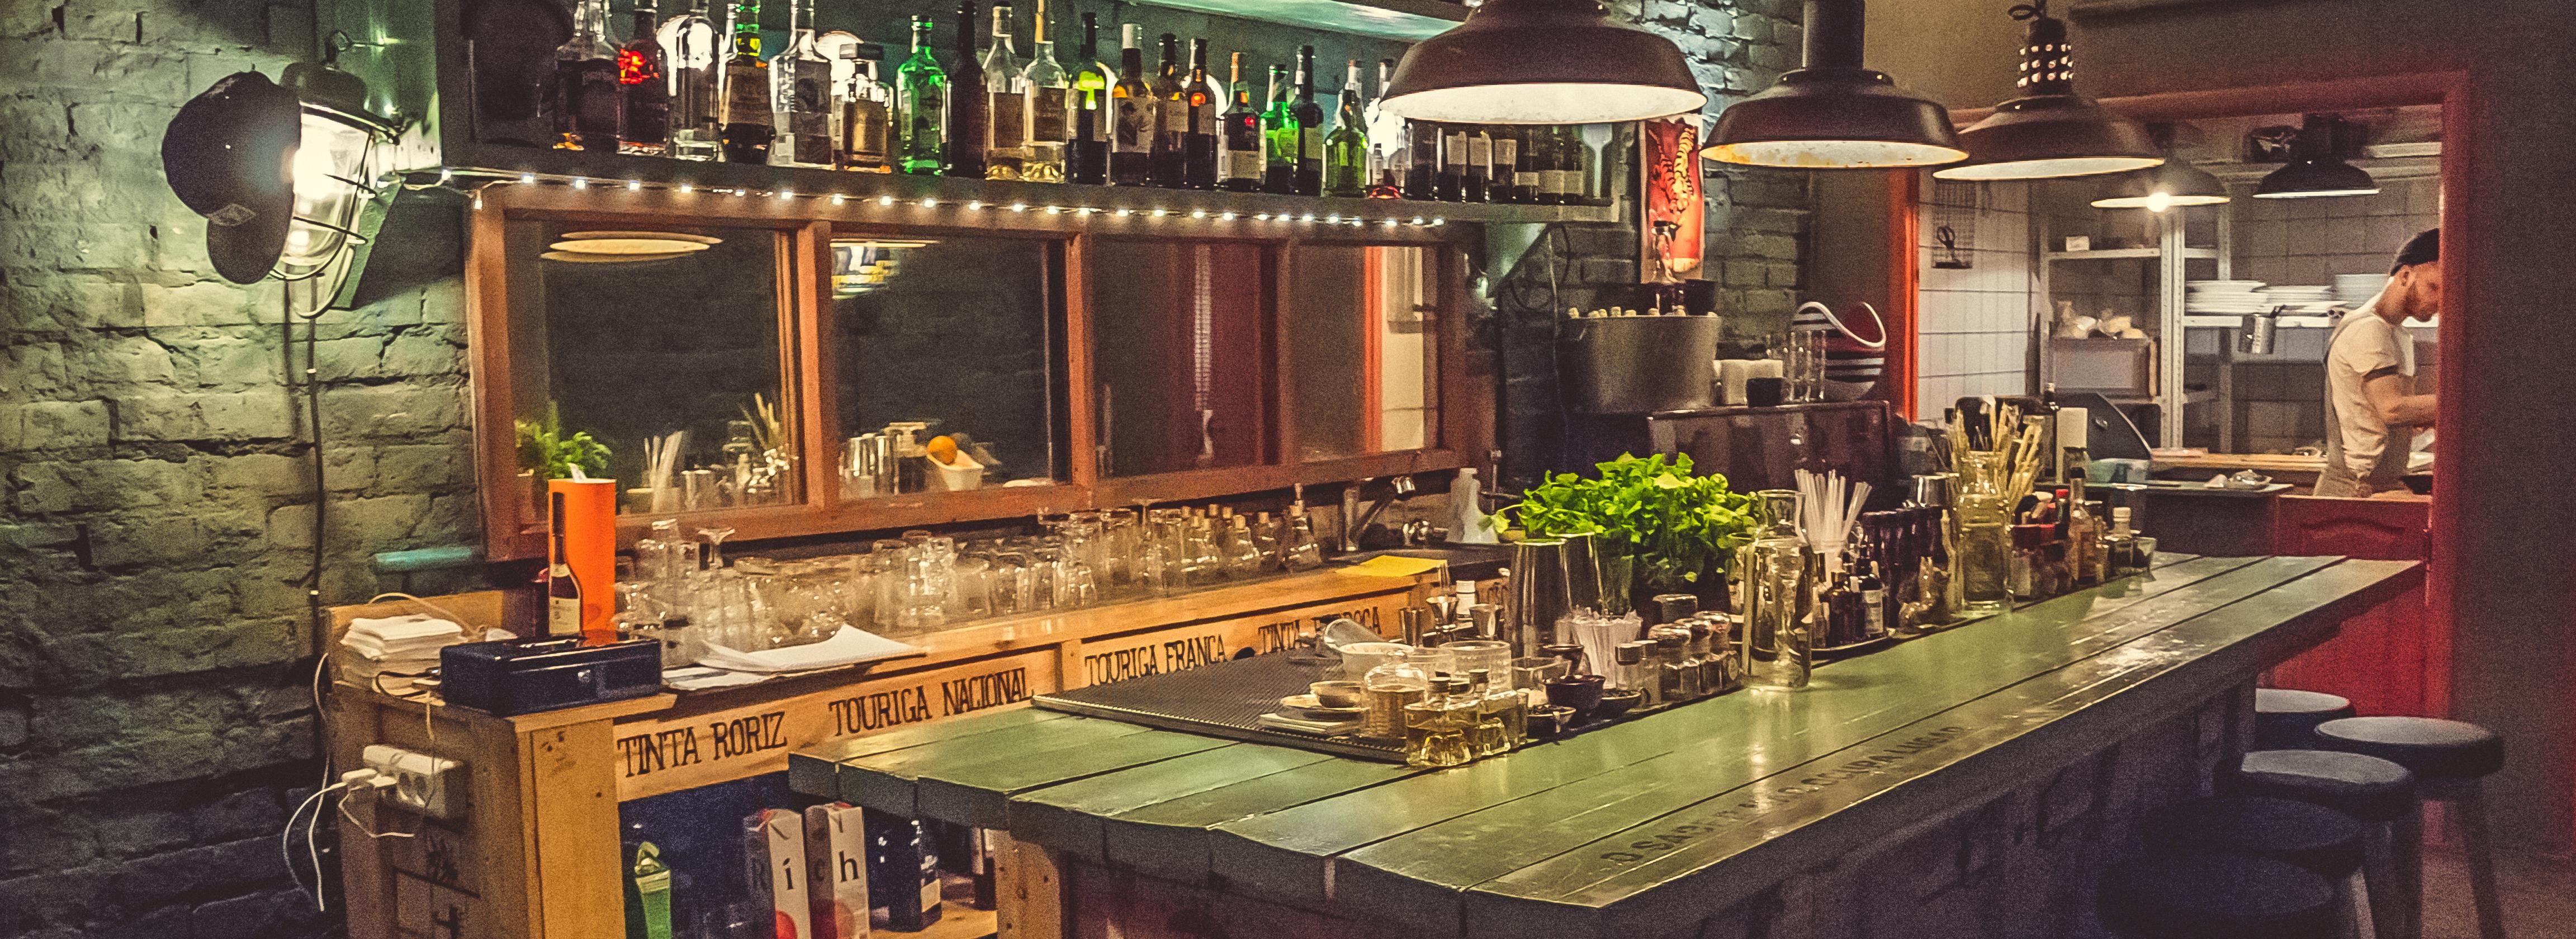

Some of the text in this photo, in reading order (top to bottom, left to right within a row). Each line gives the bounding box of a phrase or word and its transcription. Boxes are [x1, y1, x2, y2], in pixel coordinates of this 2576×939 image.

[1085, 633, 1228, 686] TOURIGA FRANCA
[1258, 619, 1301, 656] TINTA
[828, 667, 1033, 737] TOURIGA NACIONAL
[617, 710, 788, 778] TINTA RORIZ
